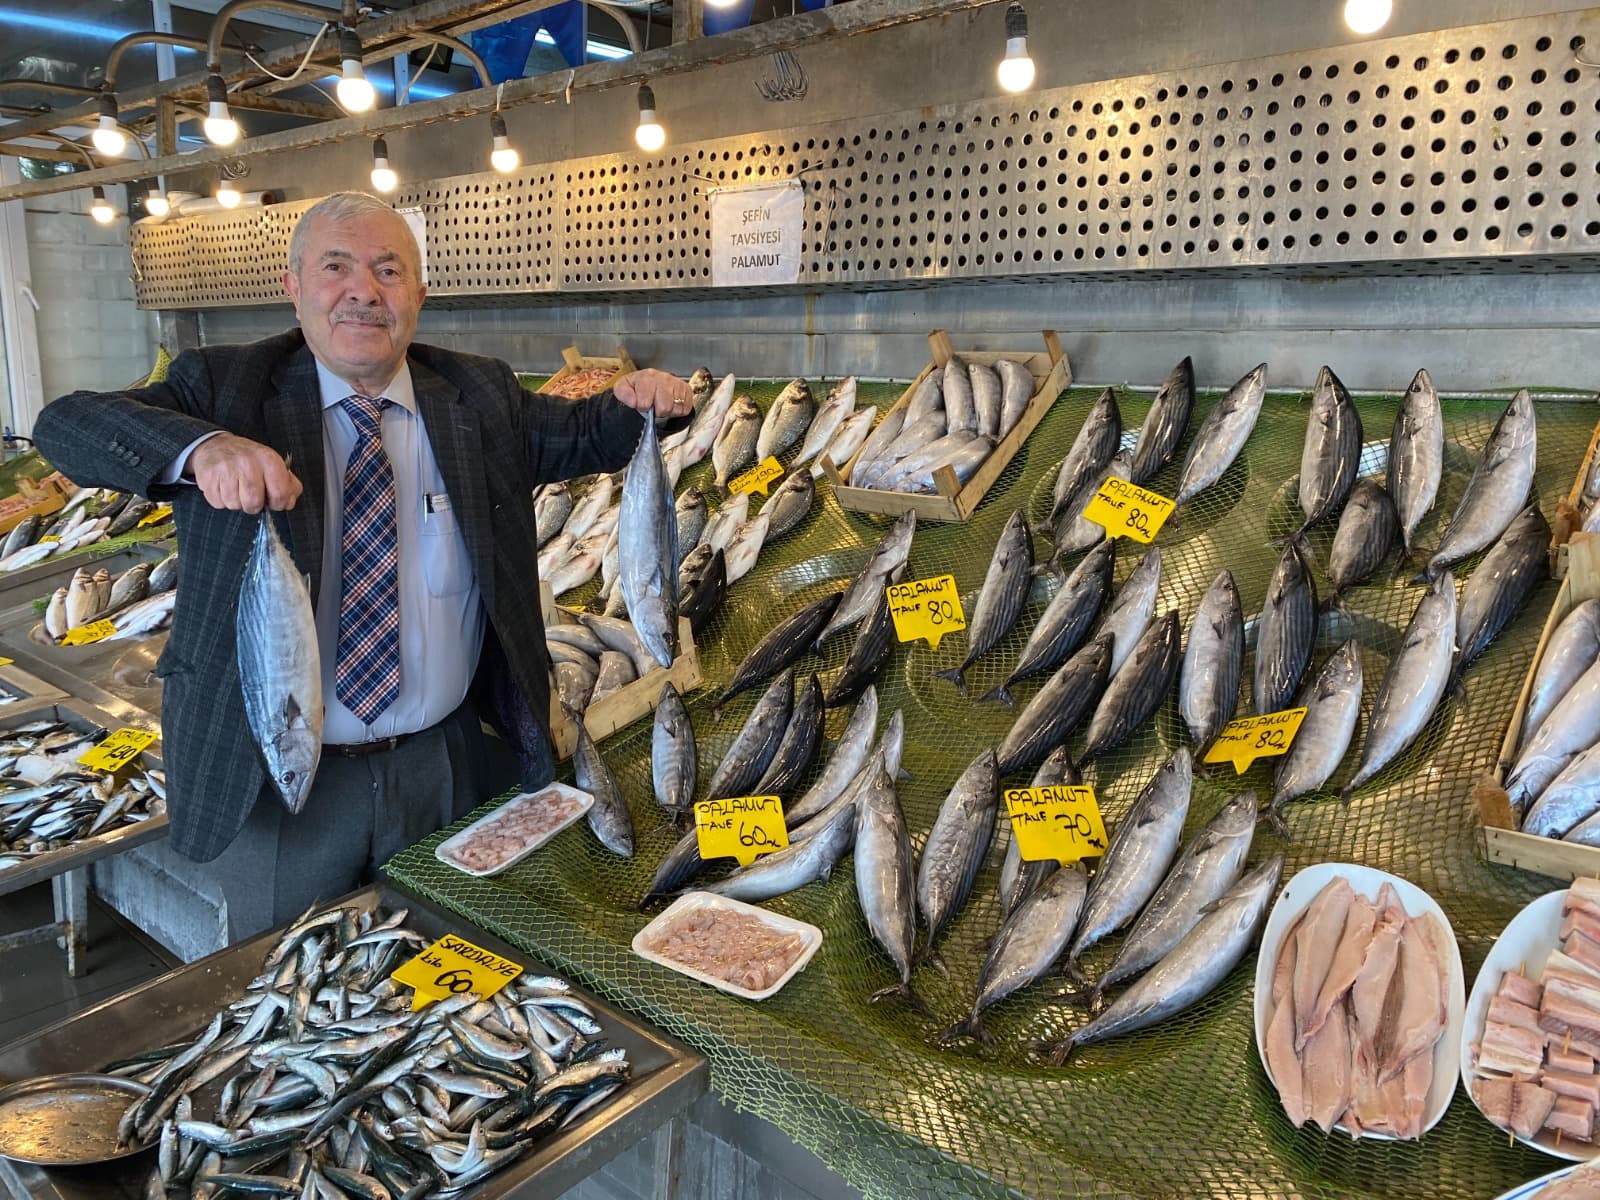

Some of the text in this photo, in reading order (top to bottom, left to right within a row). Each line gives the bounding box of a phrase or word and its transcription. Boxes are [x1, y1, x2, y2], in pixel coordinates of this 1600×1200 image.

[742, 206, 771, 226] ŞEFİN
[731, 228, 782, 247] TAVSİYESİ
[731, 253, 780, 269] PALAMUT
[1104, 479, 1171, 512] PALAMUT
[889, 578, 950, 606] PALAMUT
[927, 600, 953, 625] 80
[1224, 710, 1305, 734] PALAMUT
[698, 797, 779, 818] PALAMUT
[1008, 787, 1089, 811] PALAMUT
[696, 818, 734, 833] TANE
[739, 821, 767, 847] 60
[1054, 813, 1092, 844] 70
[439, 938, 519, 977] SARDALYE
[433, 969, 474, 994] 60
